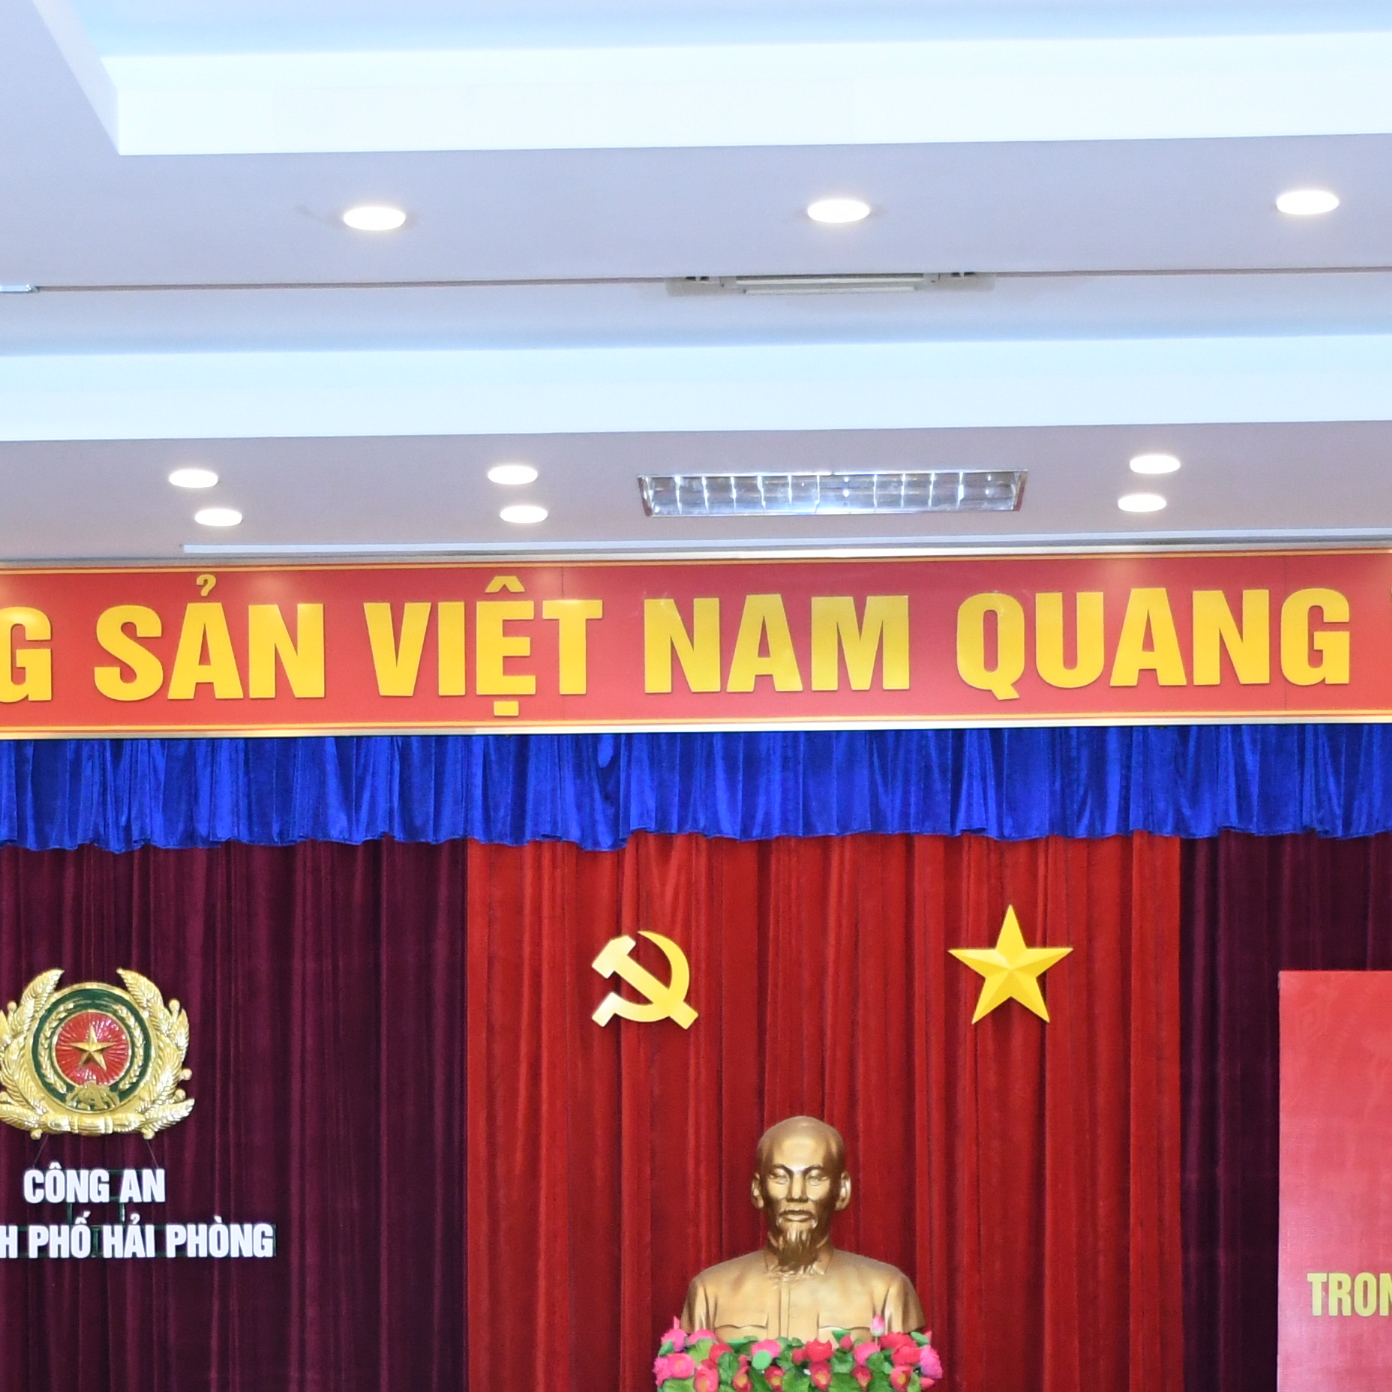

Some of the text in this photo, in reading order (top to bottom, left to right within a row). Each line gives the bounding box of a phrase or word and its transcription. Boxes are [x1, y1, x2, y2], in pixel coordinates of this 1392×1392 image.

[93, 574, 325, 701] SẢN
[364, 575, 603, 717] VIỆT
[643, 594, 910, 695] NAM
[956, 587, 1351, 700] QUANG
[23, 1161, 166, 1204] CÔNG AN
[28, 1211, 91, 1259] PHỐ
[107, 1213, 155, 1259] HẢI
[164, 1214, 274, 1258] PHÒNG
